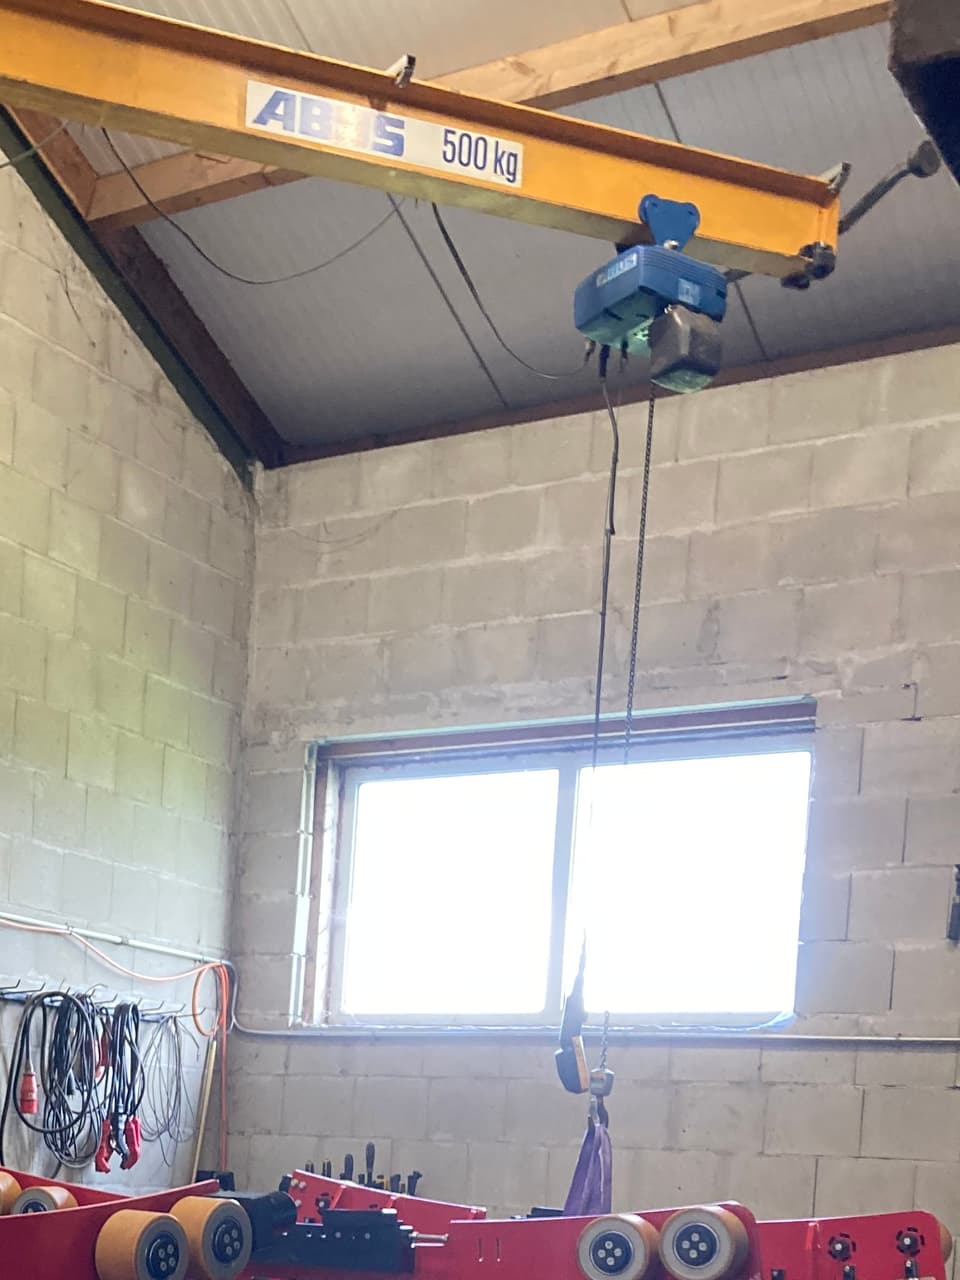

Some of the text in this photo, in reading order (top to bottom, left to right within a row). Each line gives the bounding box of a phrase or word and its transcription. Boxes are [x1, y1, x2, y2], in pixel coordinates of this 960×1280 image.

[252, 89, 519, 184] ABS 500 kg
